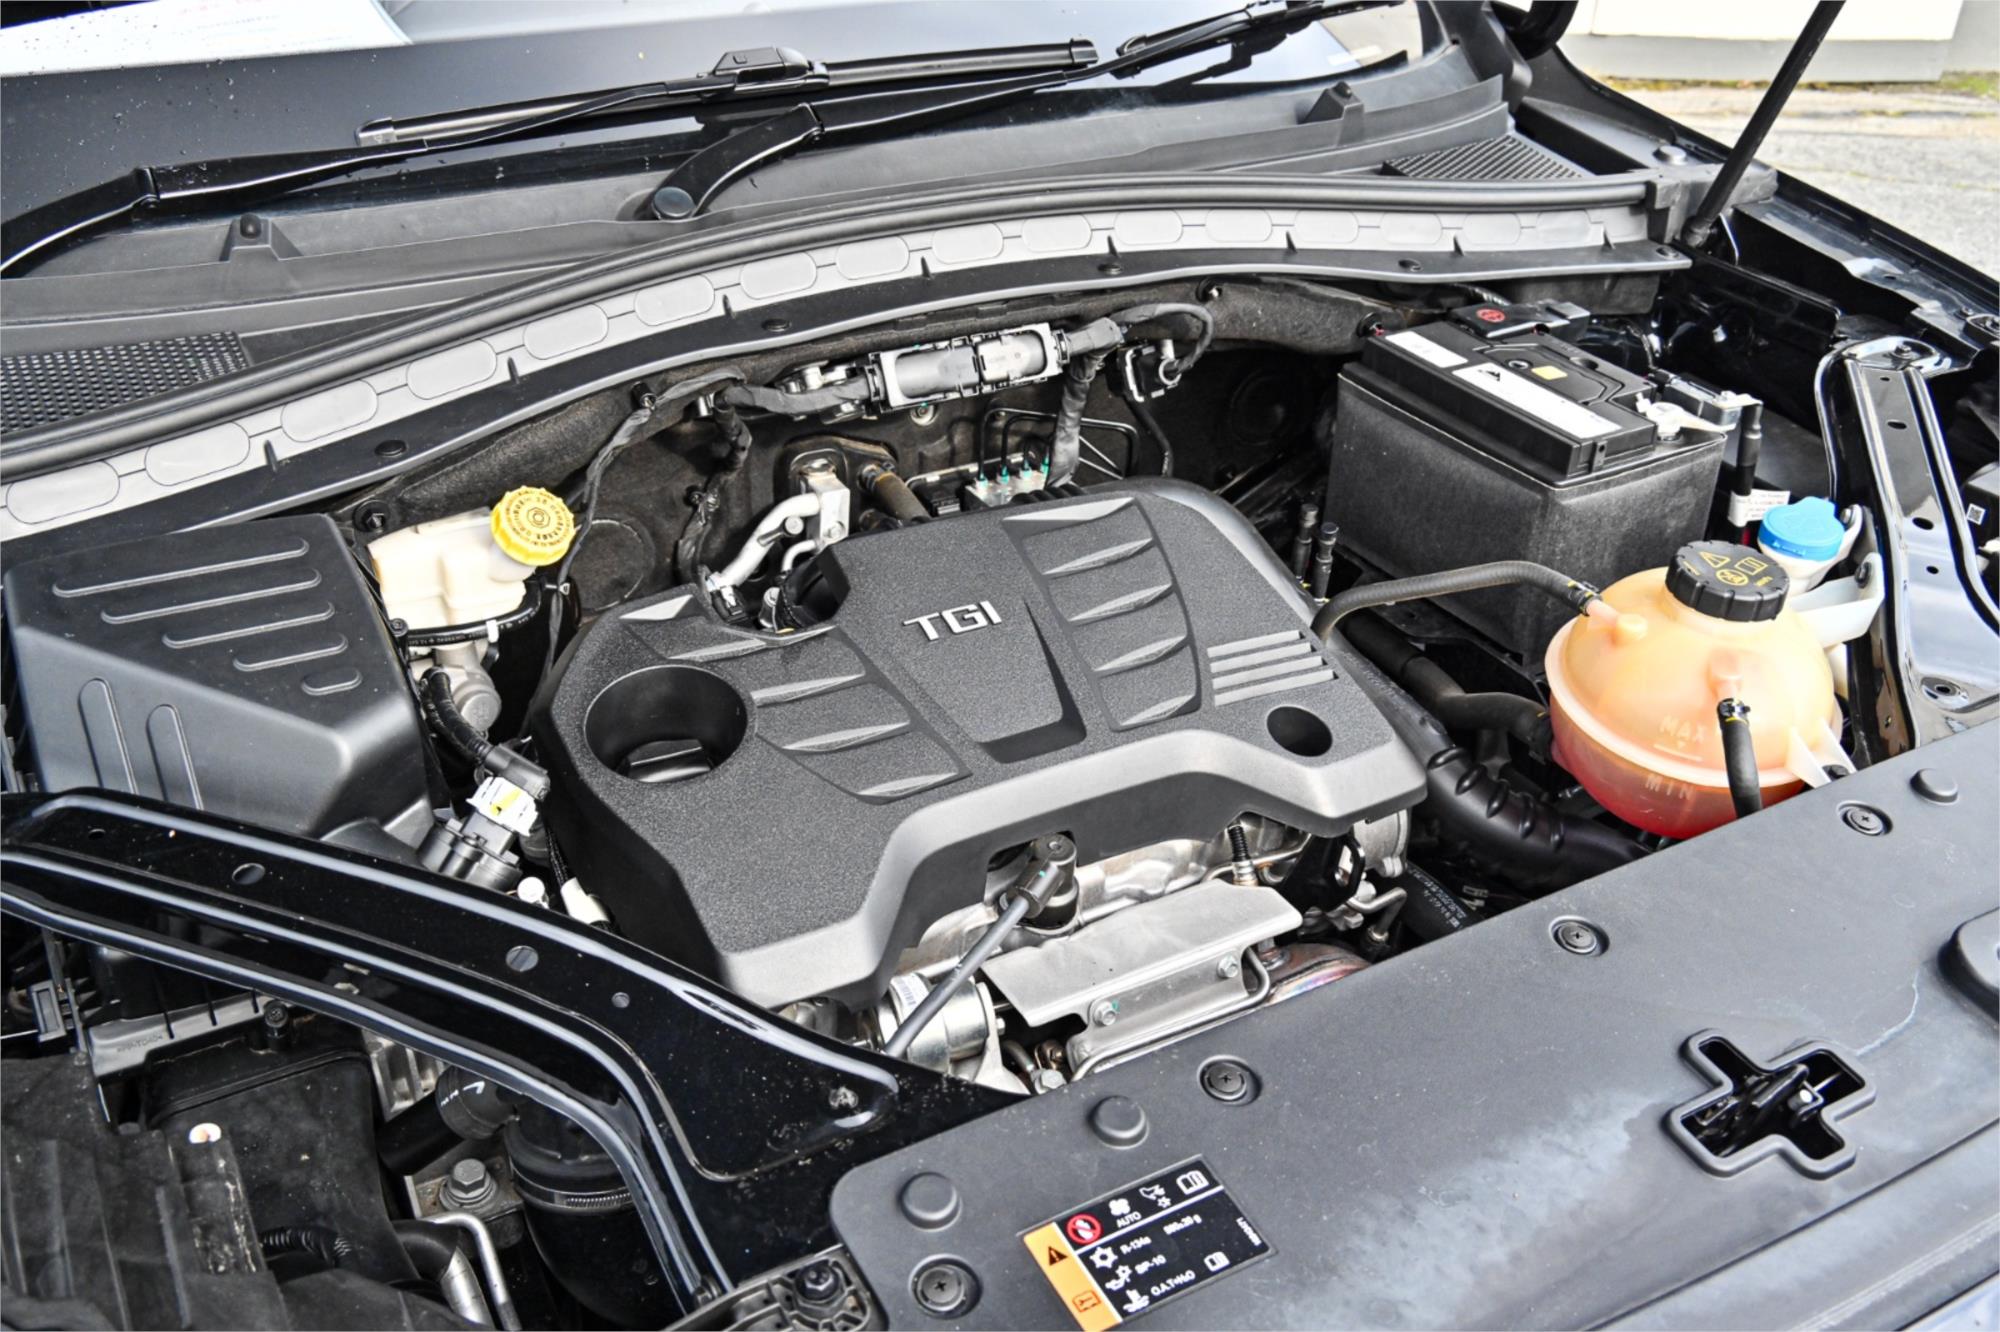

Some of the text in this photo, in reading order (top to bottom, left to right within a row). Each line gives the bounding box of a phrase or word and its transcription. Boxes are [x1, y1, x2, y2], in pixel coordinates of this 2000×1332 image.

[902, 600, 1002, 640] TGI
[1659, 714, 1707, 744] MAX
[1645, 774, 1694, 800] MIN
[1116, 1211, 1142, 1229] AUTO
